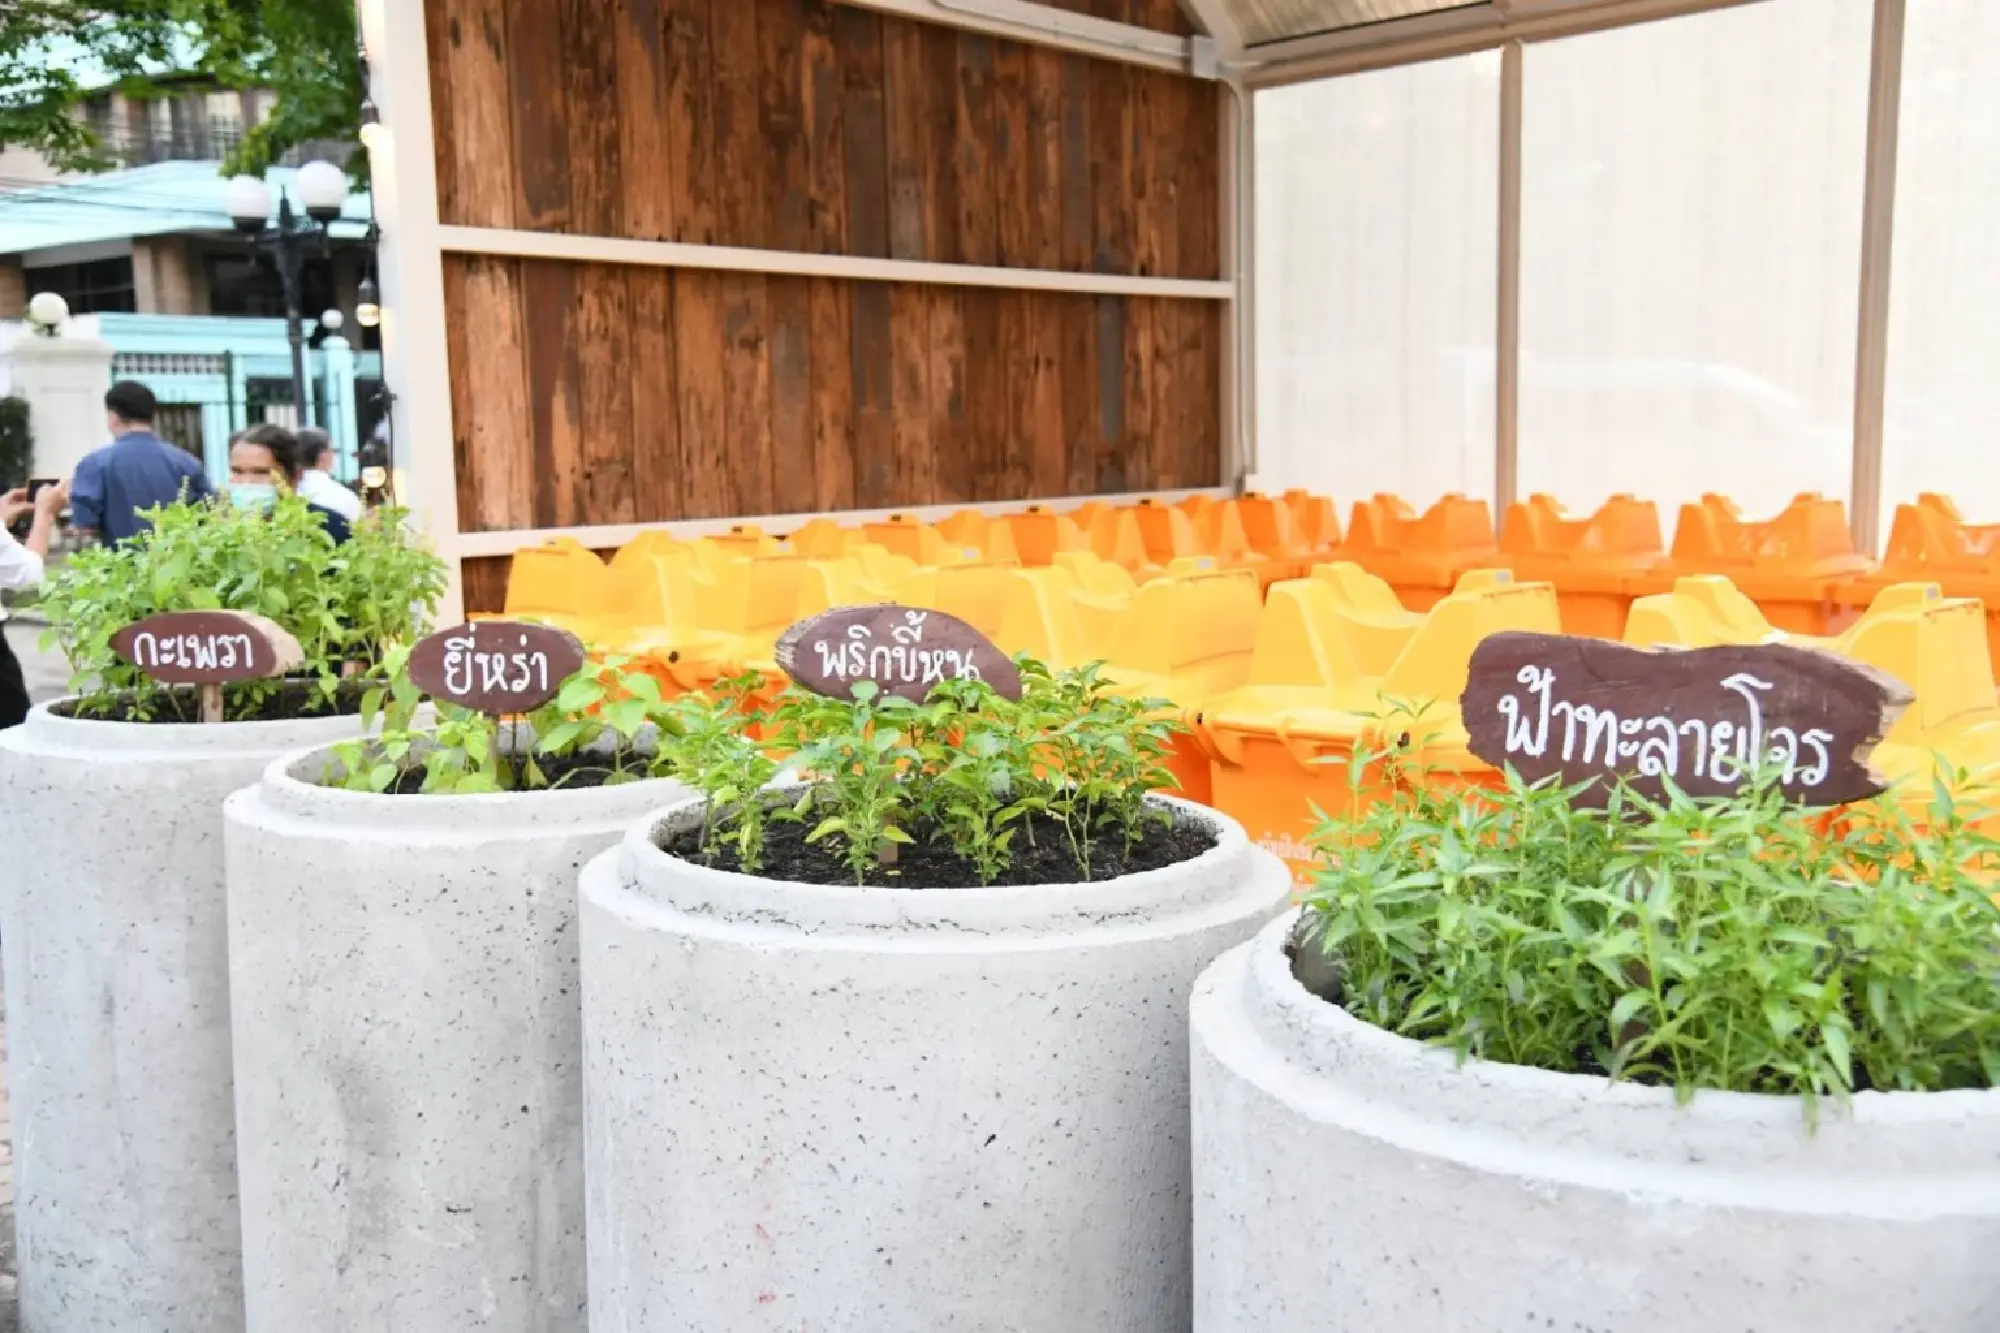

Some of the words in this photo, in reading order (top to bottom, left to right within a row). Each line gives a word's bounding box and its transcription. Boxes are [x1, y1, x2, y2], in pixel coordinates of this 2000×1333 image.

[134, 632, 254, 669] กะเพรา
[443, 622, 548, 695] ยี่หร่า
[814, 610, 980, 683] พริกขี้หน
[1497, 664, 1834, 786] ฟ้าทะลายโจร
